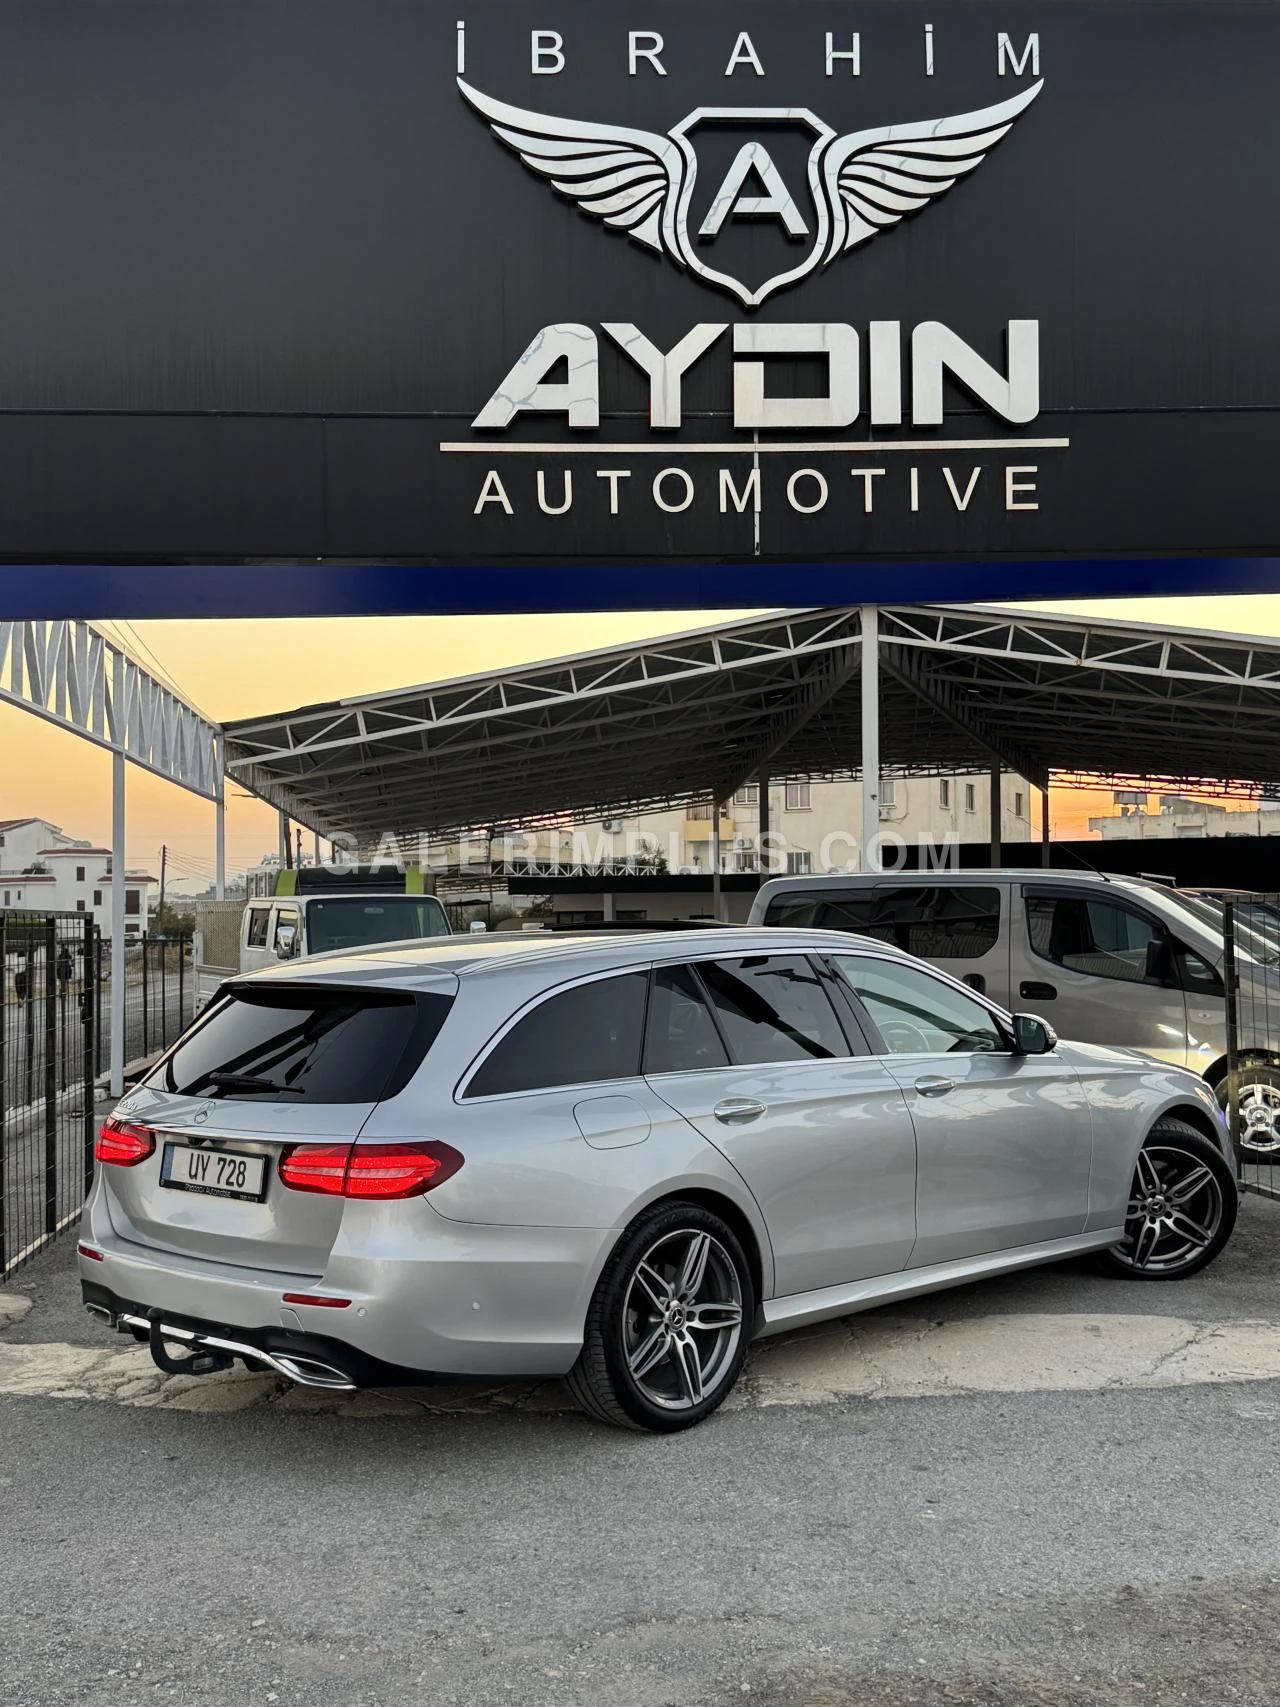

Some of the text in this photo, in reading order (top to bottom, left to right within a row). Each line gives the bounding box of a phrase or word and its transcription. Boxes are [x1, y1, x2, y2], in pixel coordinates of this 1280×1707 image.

[456, 21, 1041, 76] İBRAHİM
[698, 142, 810, 235] A
[470, 320, 1040, 428] AYDIN
[473, 466, 1040, 515] AUTOMOTIVE
[188, 1152, 247, 1188] UY 728
